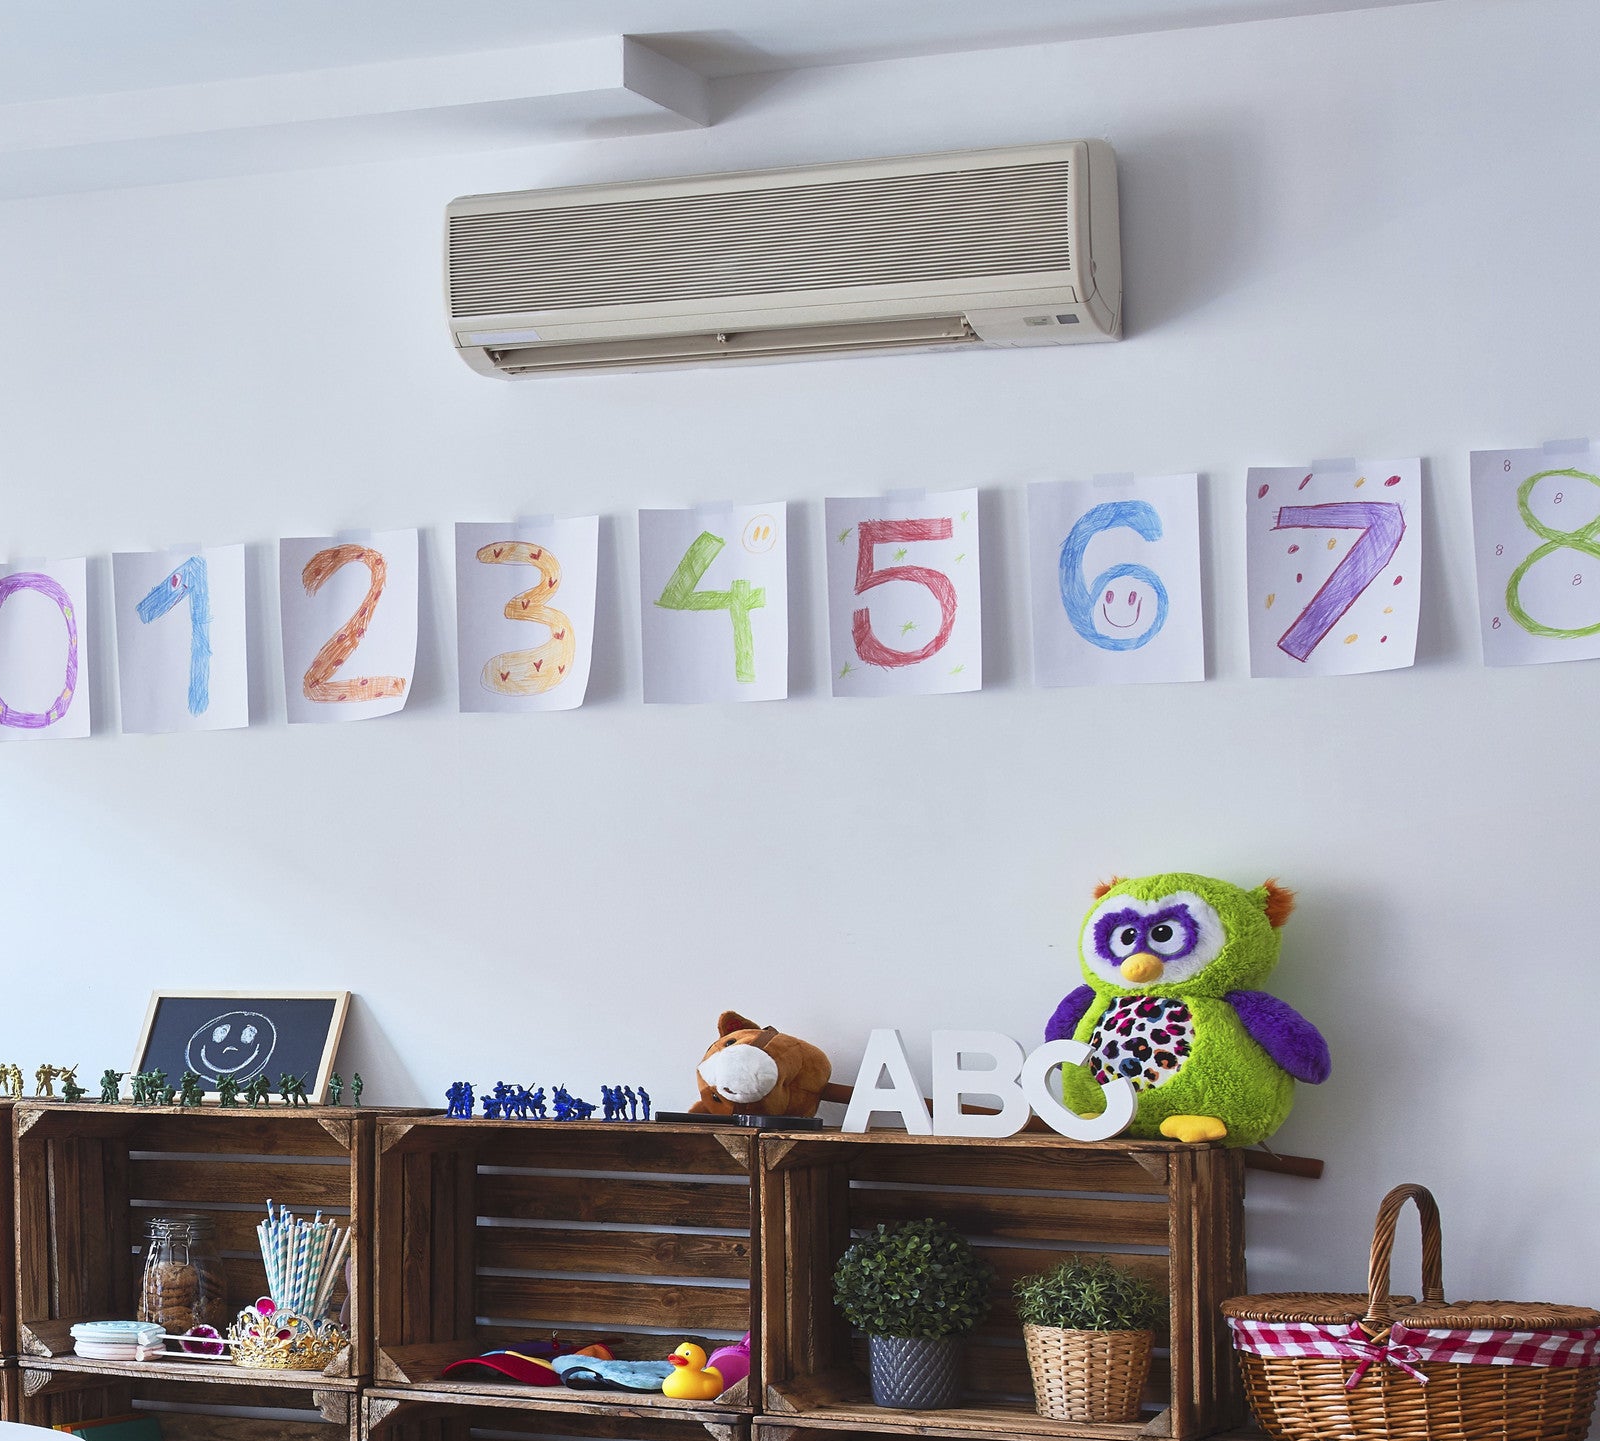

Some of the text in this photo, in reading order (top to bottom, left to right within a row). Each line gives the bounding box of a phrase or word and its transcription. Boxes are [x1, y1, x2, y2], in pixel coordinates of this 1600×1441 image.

[1504, 459, 1512, 472] 8
[1554, 493, 1564, 504] 8
[302, 543, 407, 702] 2
[475, 540, 577, 696] 3
[653, 530, 766, 684] 4
[853, 517, 956, 670] 5
[1059, 500, 1169, 652] 6
[1269, 501, 1406, 665] 7
[1492, 616, 1501, 630] 8
[1496, 543, 1504, 556] 8
[1505, 466, 1600, 639] 8
[1572, 574, 1582, 586] 8
[135, 555, 213, 718] 1
[841, 1028, 1138, 1142] ABC
